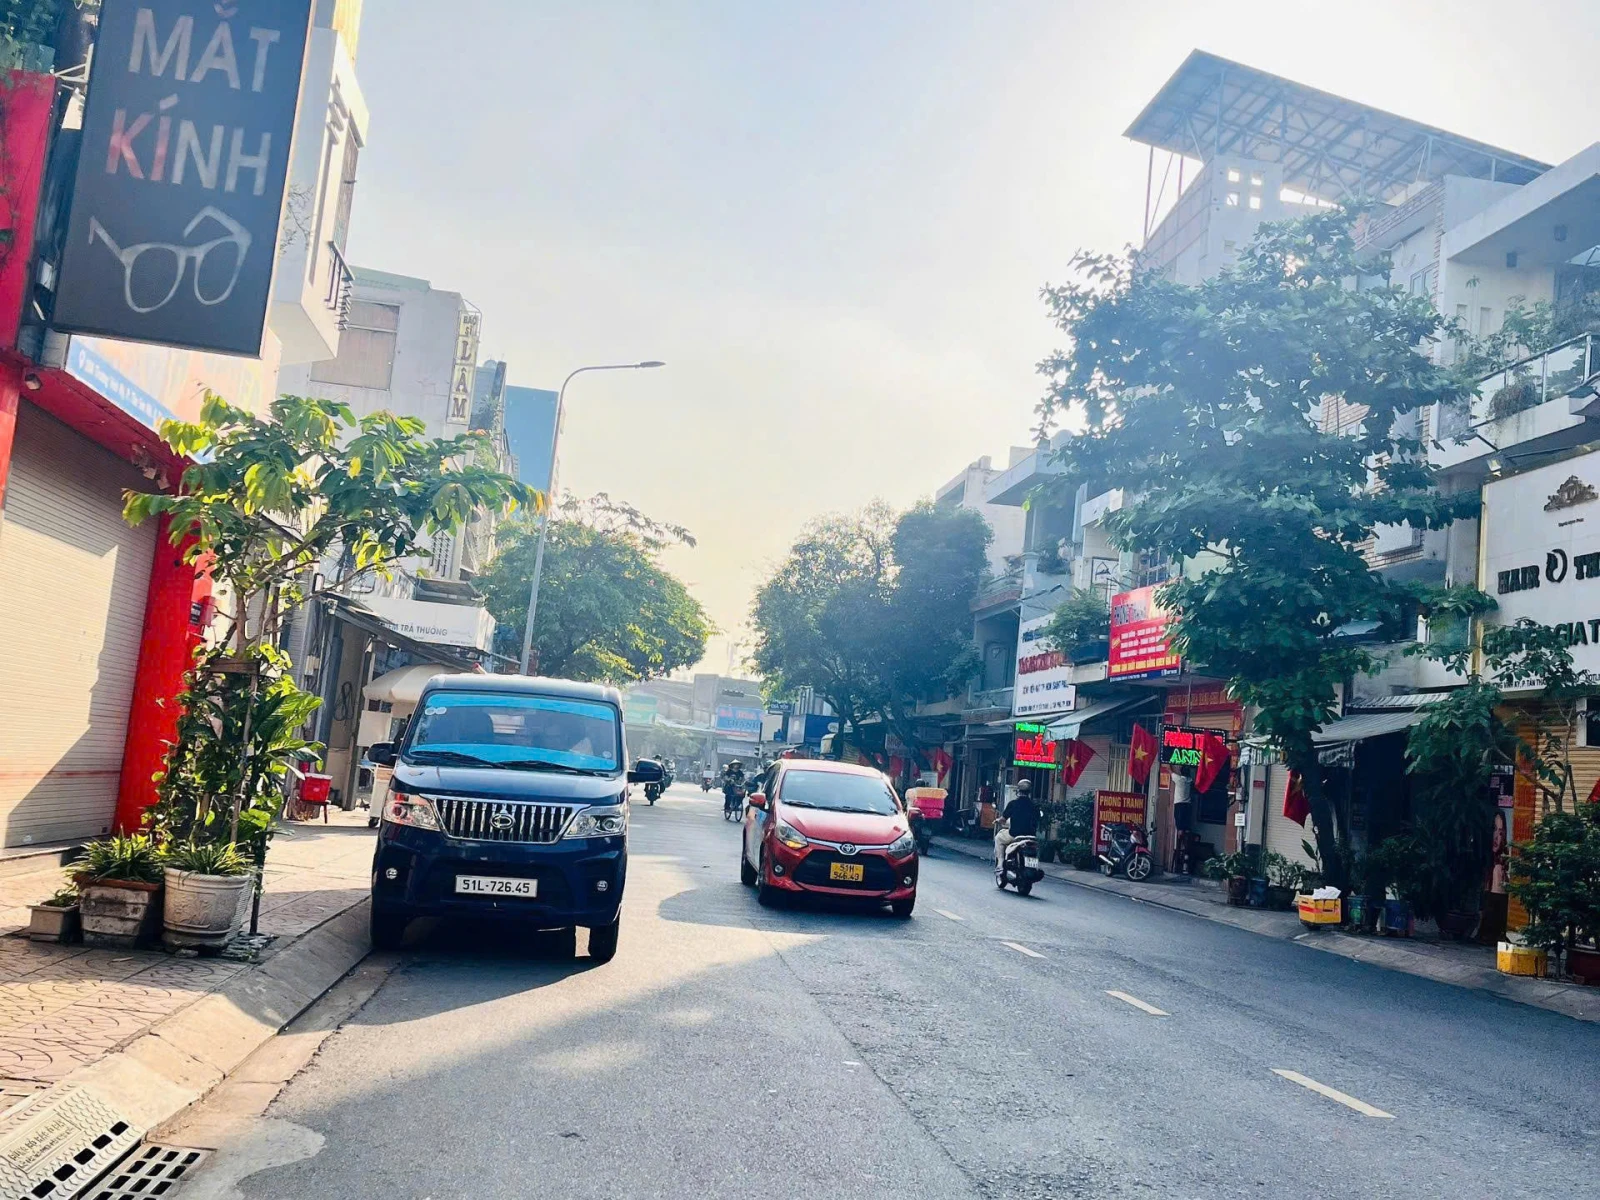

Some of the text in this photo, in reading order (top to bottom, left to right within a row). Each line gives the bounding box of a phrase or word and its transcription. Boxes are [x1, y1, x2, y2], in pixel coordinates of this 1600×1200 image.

[106, 94, 271, 195] KÍNH
[1498, 565, 1540, 594] HAIR
[462, 879, 531, 894] 51L-726.45
